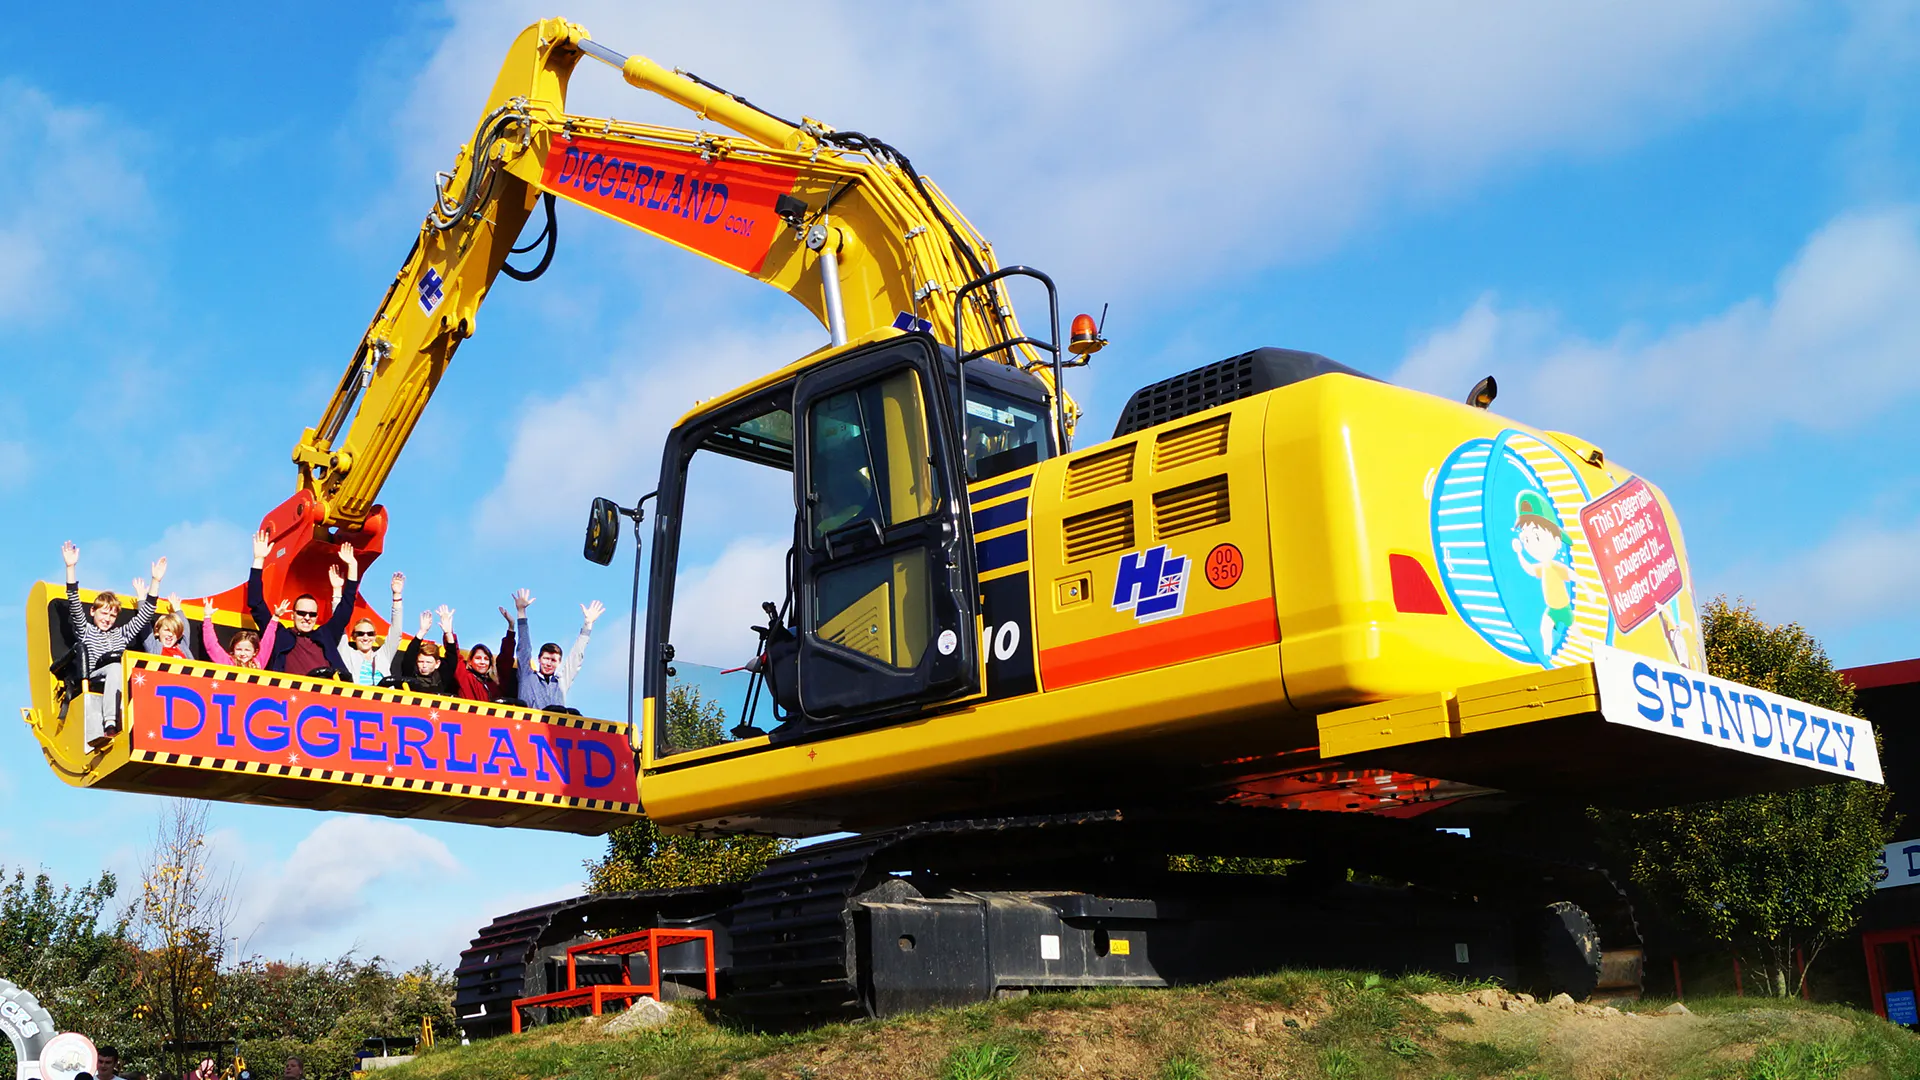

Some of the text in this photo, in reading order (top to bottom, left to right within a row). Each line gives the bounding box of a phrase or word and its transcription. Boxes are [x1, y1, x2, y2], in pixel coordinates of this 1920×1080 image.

[558, 146, 728, 224] DIGGERLAND
[1589, 484, 1653, 538] This Diggerland
[1612, 512, 1654, 554] machine is
[1211, 563, 1238, 581] 350
[1215, 548, 1233, 565] 00
[1614, 539, 1651, 584] powered
[1613, 576, 1650, 615] Naughty
[154, 685, 617, 788] DIGGERLAND
[1632, 662, 1856, 772] SPINDIZZY
